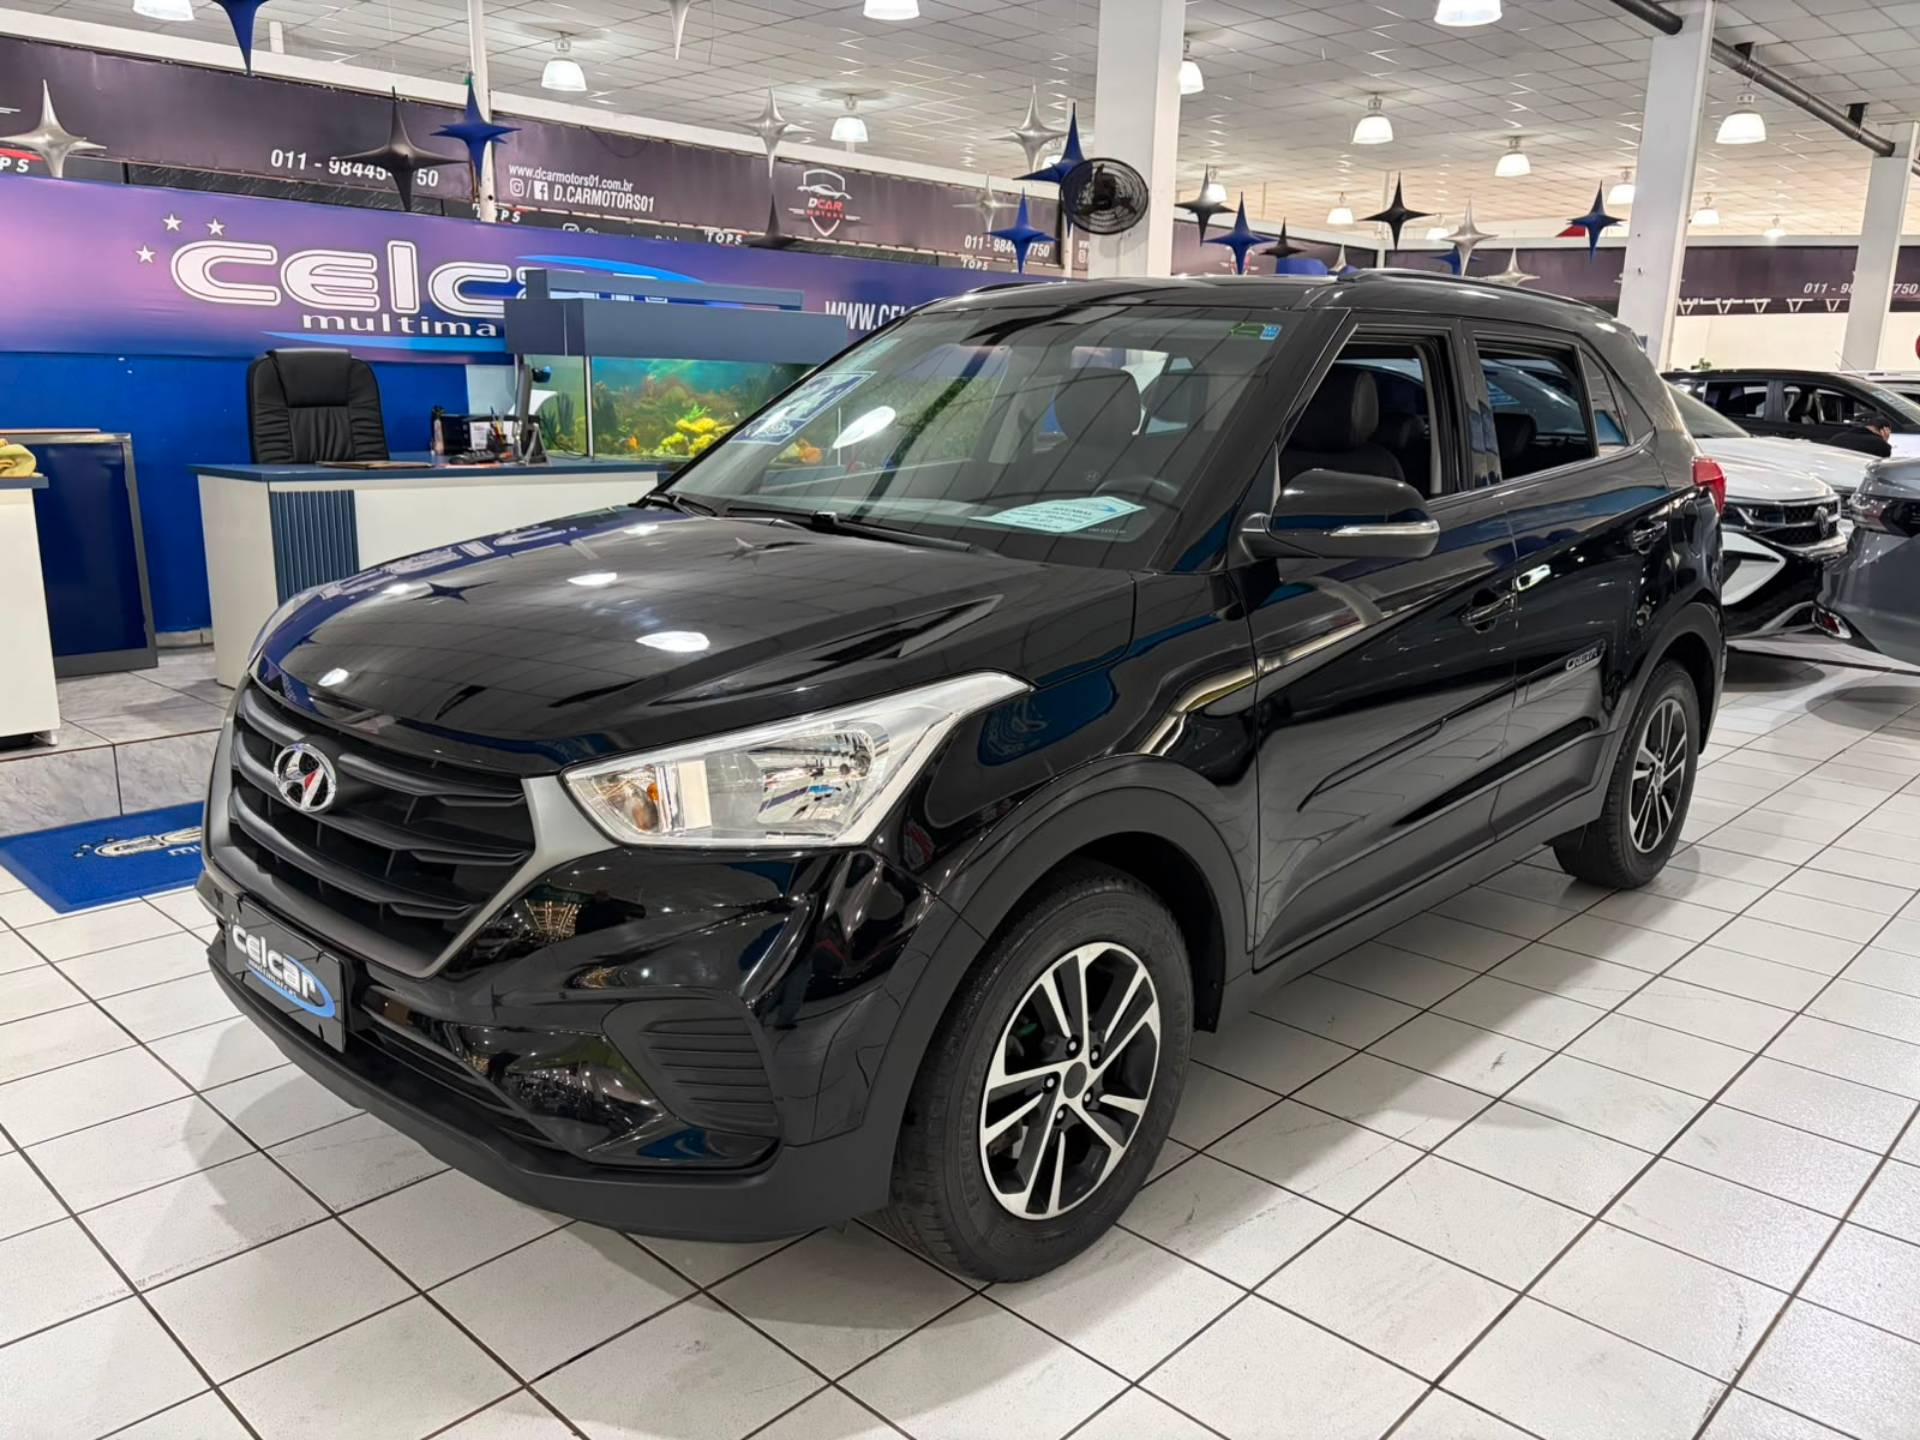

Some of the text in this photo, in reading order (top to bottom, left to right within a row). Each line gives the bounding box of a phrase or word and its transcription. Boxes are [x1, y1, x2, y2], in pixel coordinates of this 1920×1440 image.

[270, 148, 308, 171] 011
[328, 156, 439, 187] 98445-50
[508, 164, 634, 192] www.dcarmotors01.com.br
[553, 183, 655, 213] D.CARMOTORS01
[807, 197, 844, 211] DCAR
[706, 231, 743, 246] TOPS
[964, 234, 984, 250] 011
[961, 257, 989, 271] TOPS
[170, 239, 668, 319] celc
[1803, 282, 1829, 294] 011
[302, 312, 498, 337] multima
[232, 924, 316, 999] celcar
